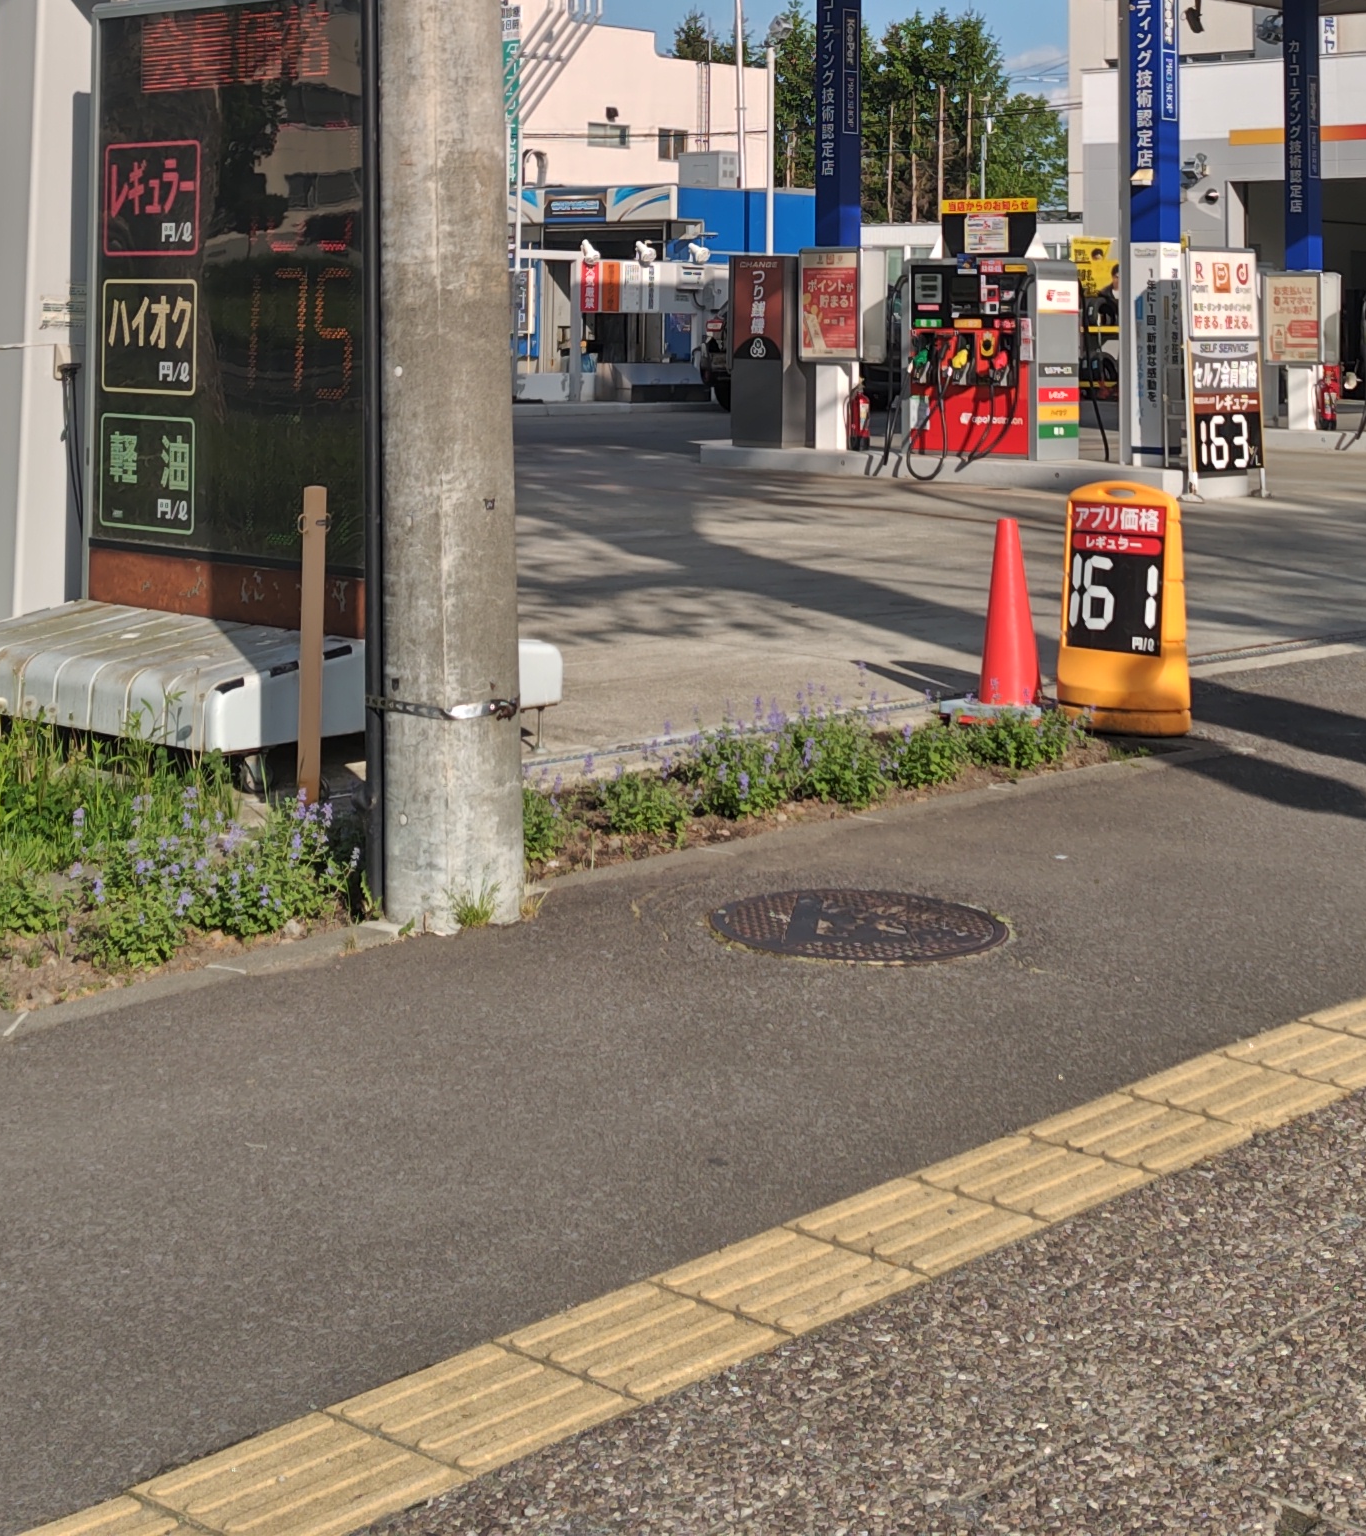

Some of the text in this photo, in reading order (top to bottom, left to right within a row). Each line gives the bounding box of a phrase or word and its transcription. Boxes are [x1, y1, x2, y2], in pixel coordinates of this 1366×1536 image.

[846, 18, 856, 65] KeePer
[1288, 40, 1303, 213] カーコーティング技術認定店
[111, 158, 195, 218] レギュラー
[948, 200, 1029, 212] 当店からのお知らせ
[807, 279, 854, 293] ポイントが
[108, 296, 192, 349] ハイオク
[1200, 343, 1249, 353] SELF SERVICE
[1193, 360, 1257, 389] セルフ会員価格
[1215, 394, 1258, 411] レギュラー
[1200, 414, 1249, 469] 163
[109, 431, 190, 492] 軽油
[1075, 506, 1159, 532] アプリ価格
[1085, 535, 1143, 550] レギュラー
[1069, 553, 1159, 631] 161
